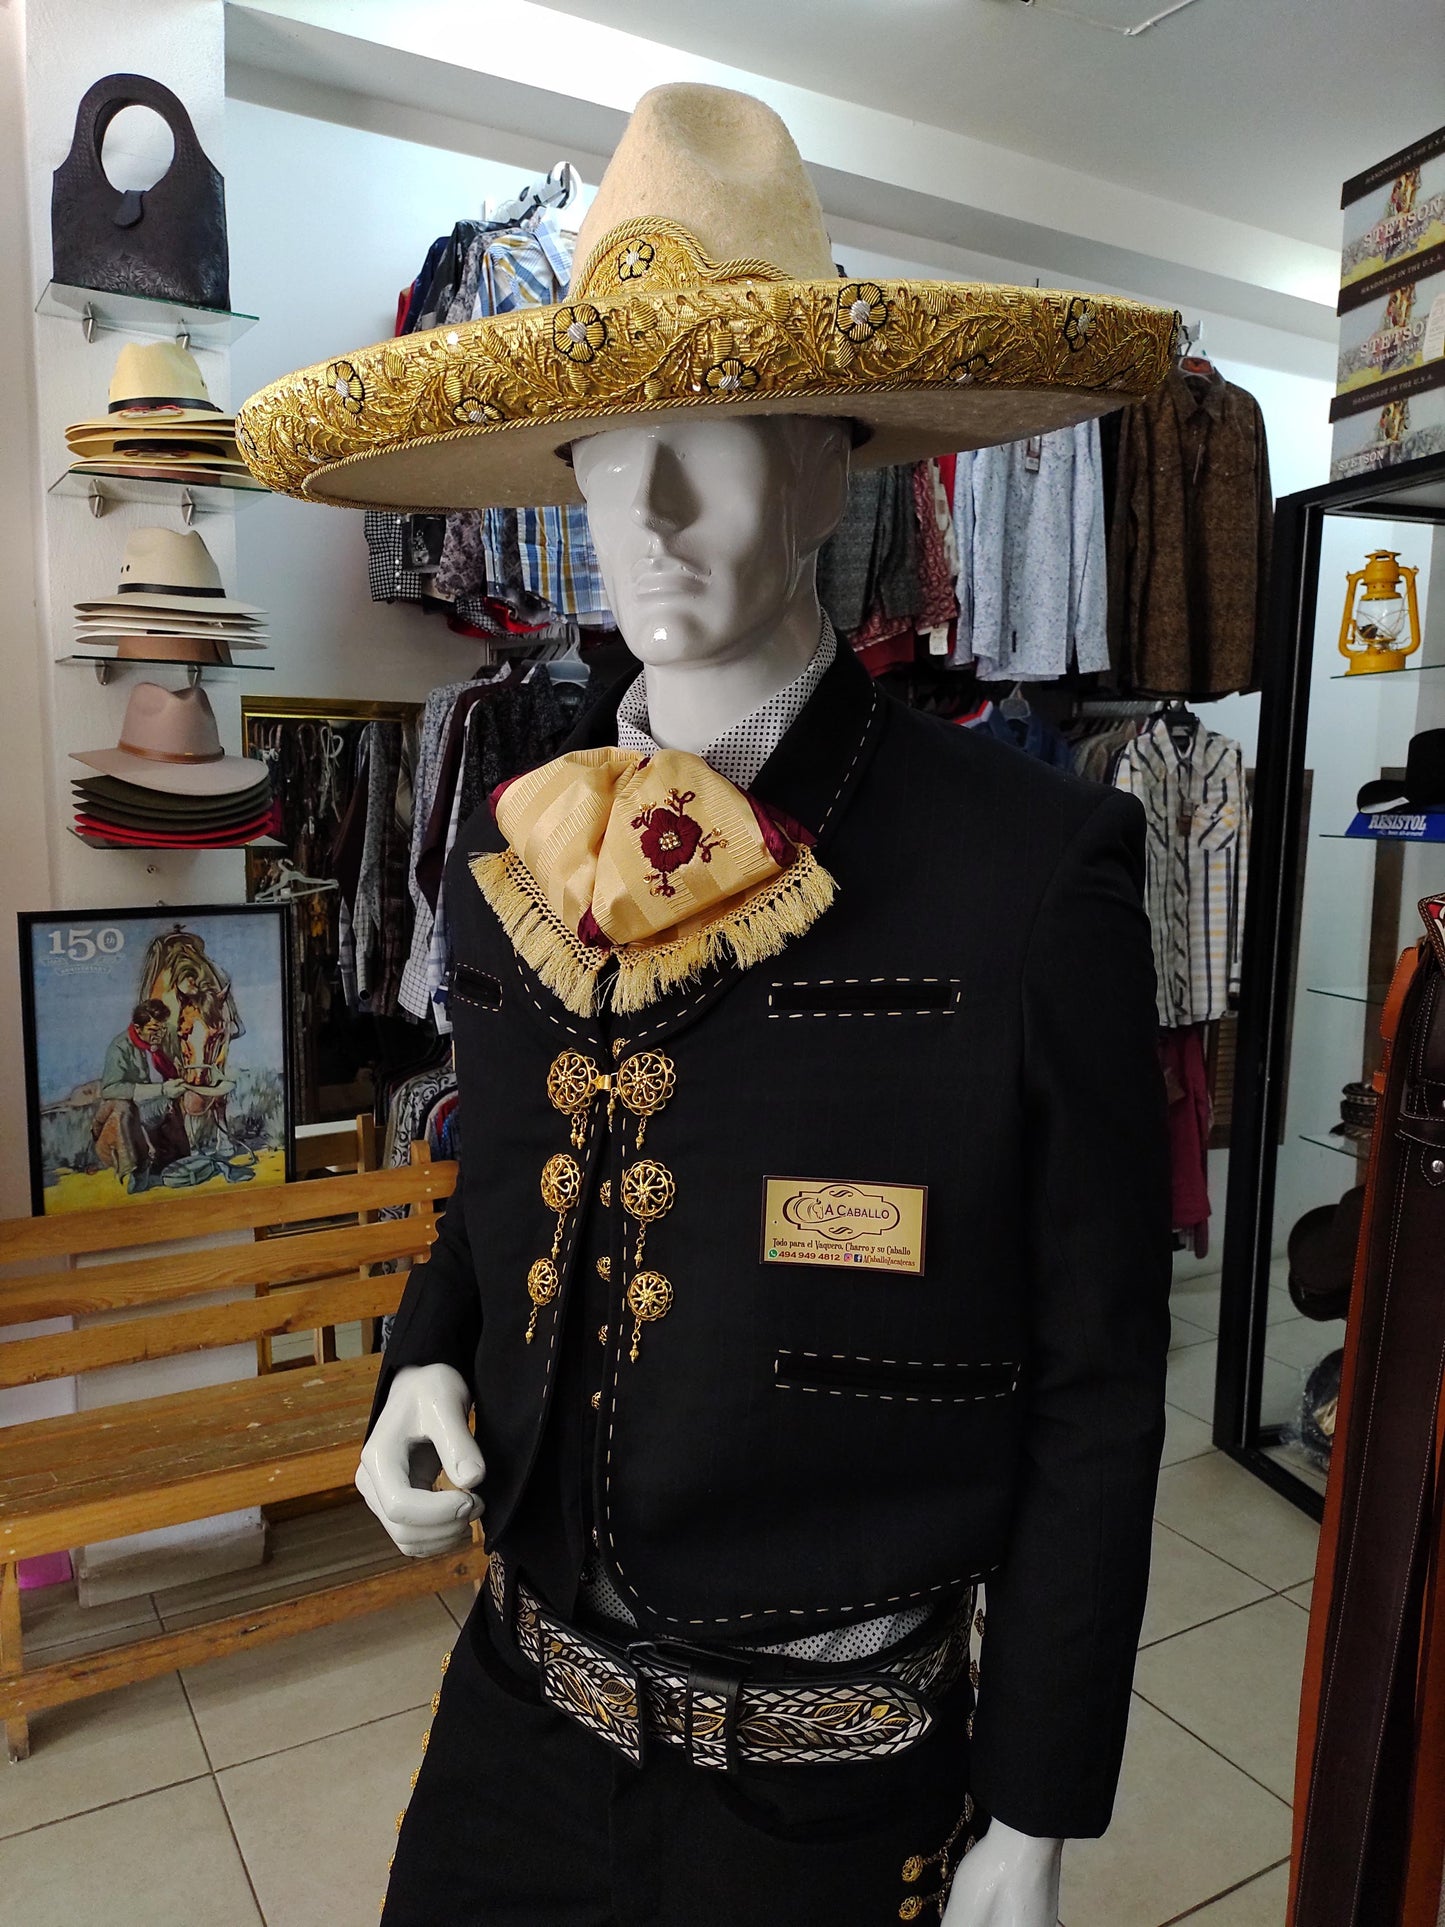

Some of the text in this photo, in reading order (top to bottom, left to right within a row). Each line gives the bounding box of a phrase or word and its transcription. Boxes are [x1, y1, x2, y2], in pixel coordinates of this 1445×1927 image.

[1363, 198, 1442, 248] STETSON
[1360, 316, 1427, 357] STETSO
[1338, 449, 1385, 471] STETSON
[1368, 814, 1427, 831] RESISTOL
[824, 1203, 834, 1216] A
[773, 1238, 788, 1248] Todo
[789, 1241, 806, 1249] para
[807, 1240, 813, 1248] el
[845, 1242, 870, 1252] Charro
[886, 1245, 911, 1255] Caballo
[818, 1253, 841, 1261] 4812
